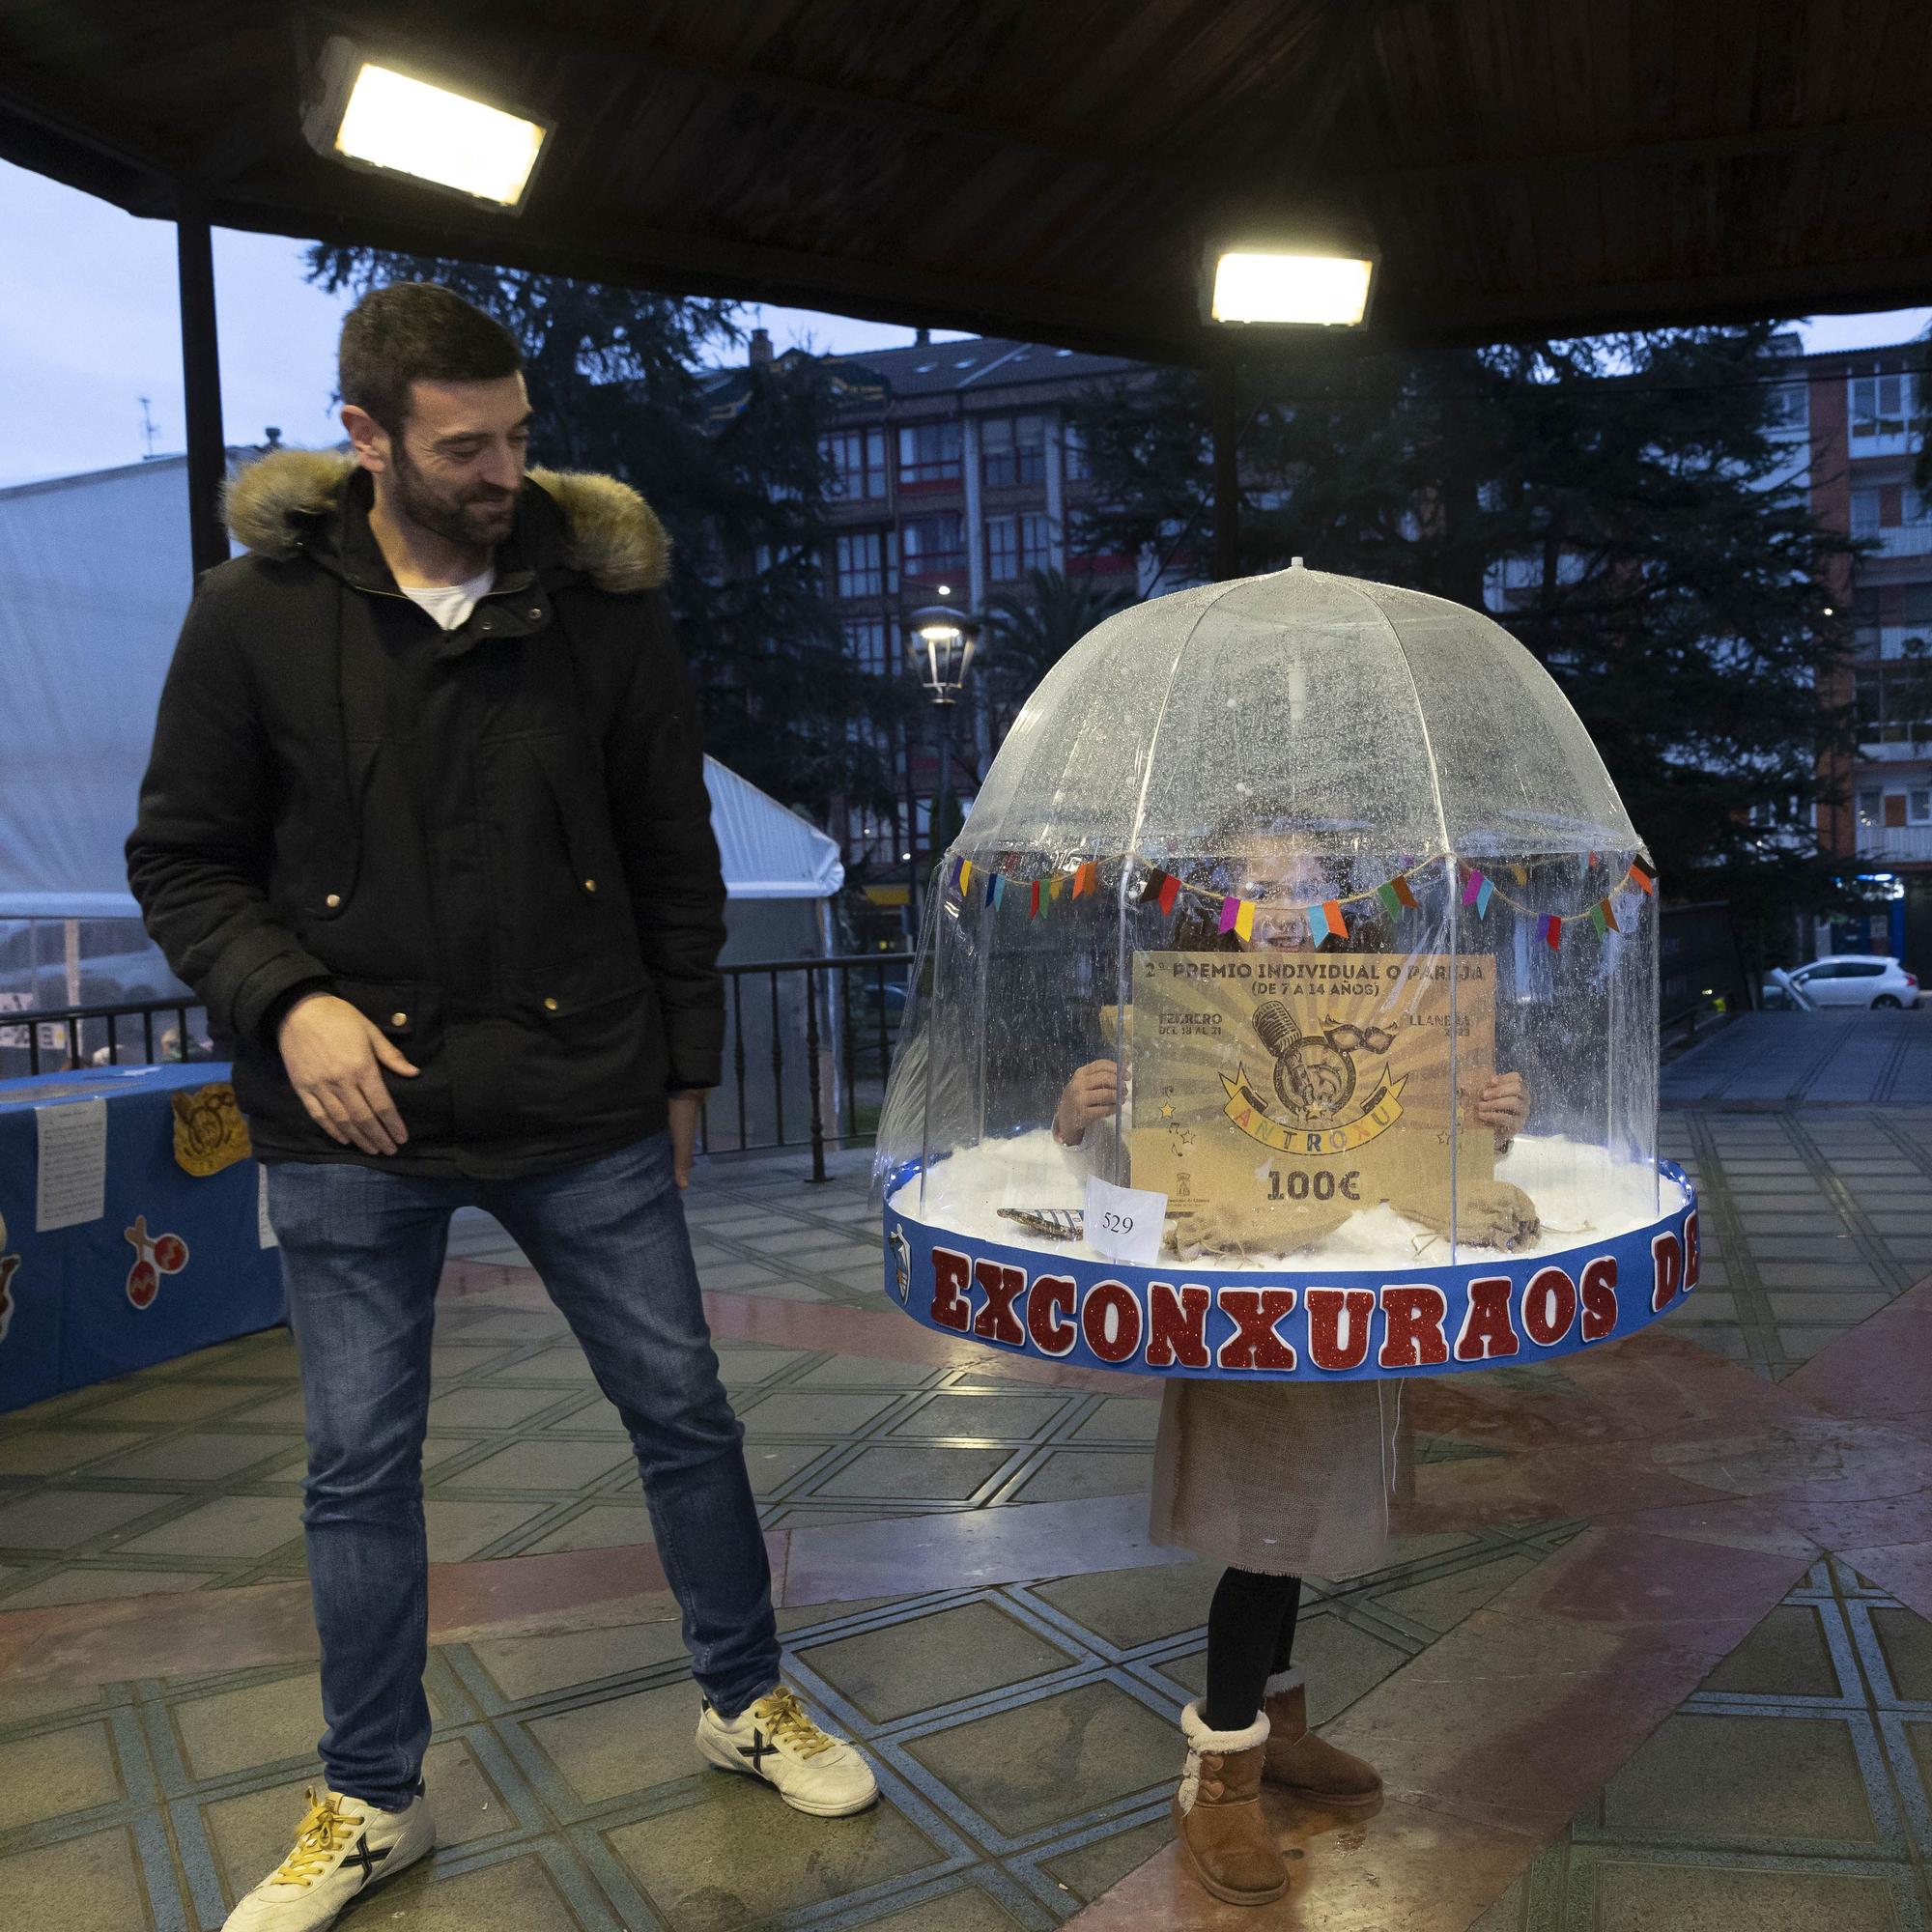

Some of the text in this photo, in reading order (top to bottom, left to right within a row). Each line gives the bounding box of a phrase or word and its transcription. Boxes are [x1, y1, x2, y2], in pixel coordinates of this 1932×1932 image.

[1173, 963, 1252, 979] PREMIO
[1258, 963, 1379, 980] INDIVIDUAL
[1386, 965, 1401, 980] O
[1252, 980, 1379, 997] (DE 7 A 14 AÑOS)
[1234, 1105, 1391, 1152] ANTROXU
[1267, 1170, 1361, 1201] 100€
[1102, 1211, 1134, 1235] 529
[931, 1246, 1618, 1373] EXCONXURAOS
